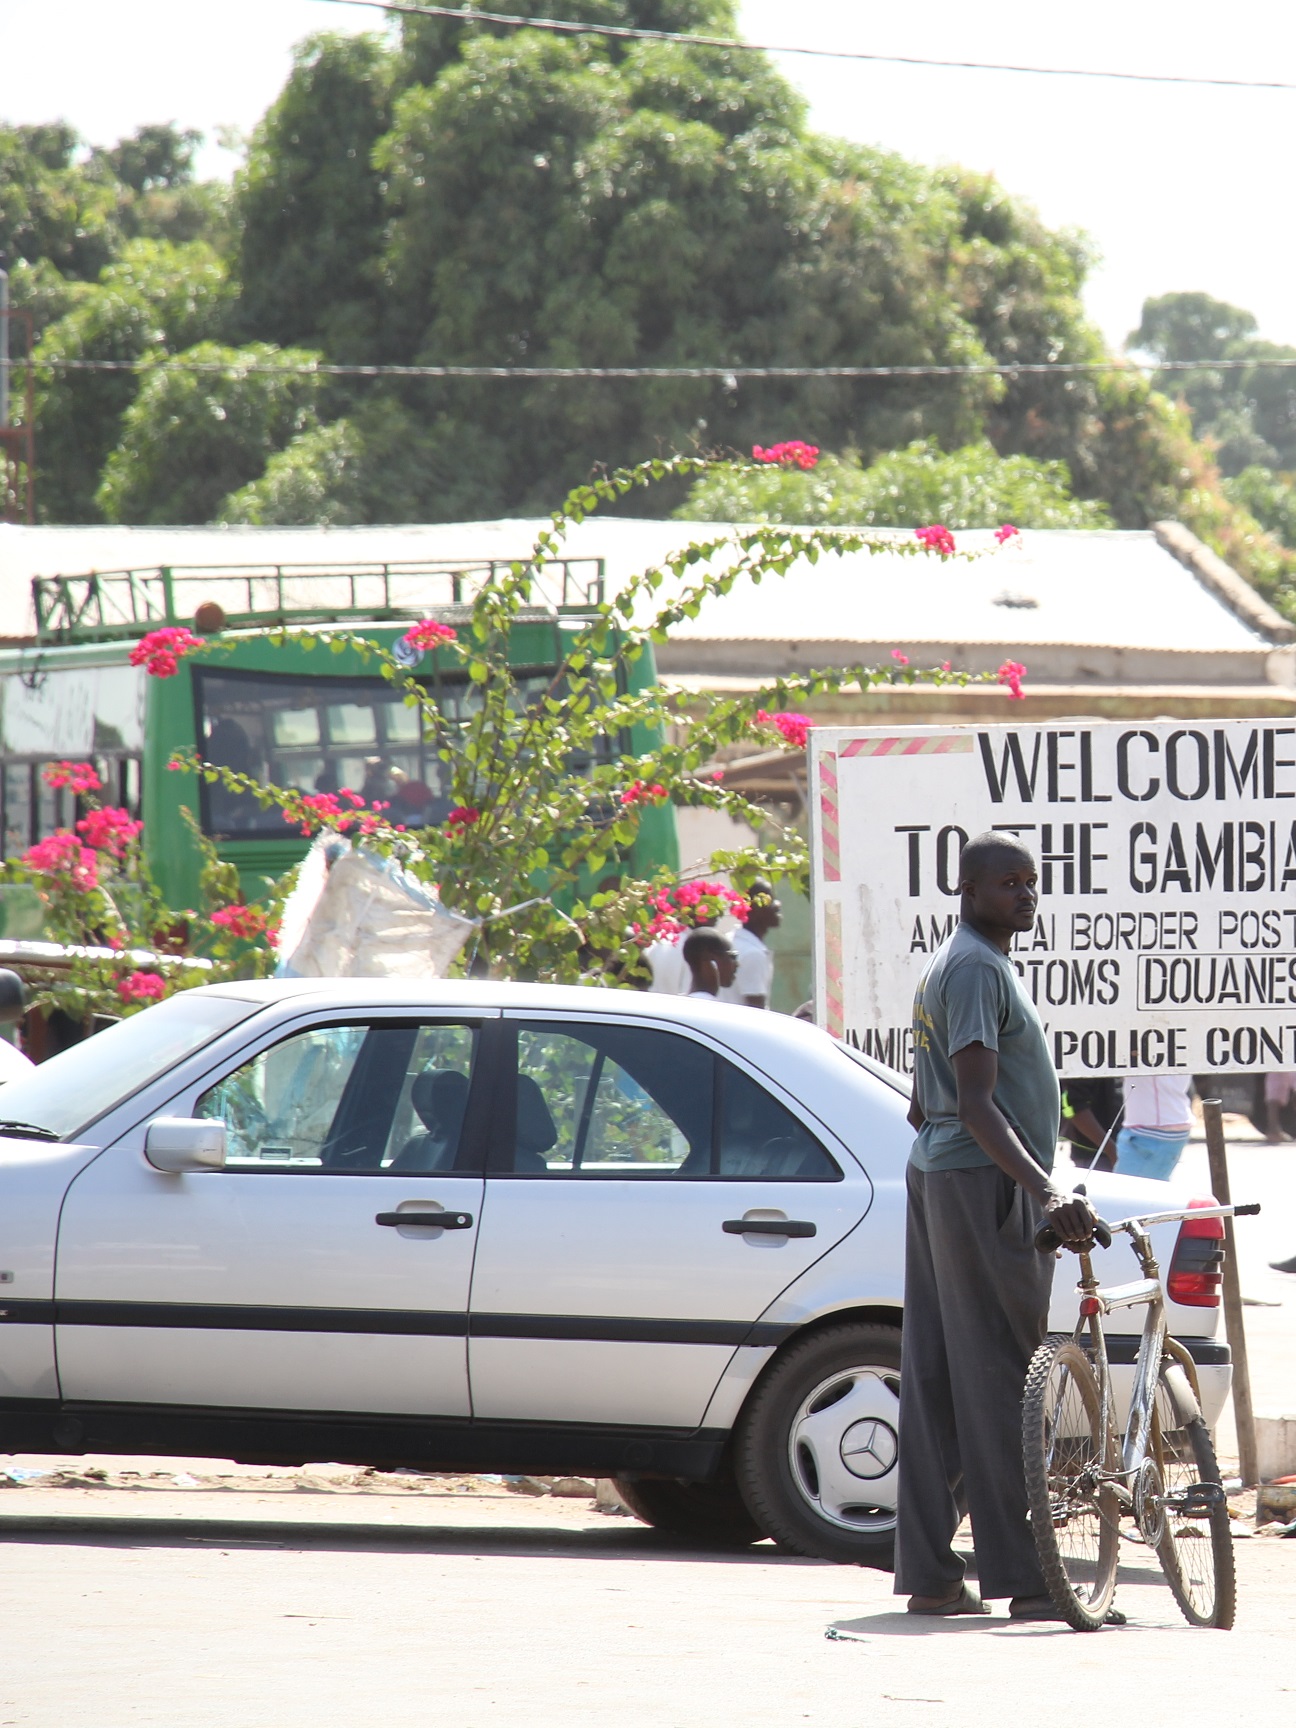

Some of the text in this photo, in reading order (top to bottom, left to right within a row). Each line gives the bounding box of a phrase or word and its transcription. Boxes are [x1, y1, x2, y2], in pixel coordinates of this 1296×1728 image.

[978, 728, 1296, 803] WELCOME
[895, 825, 969, 897] TO
[1071, 911, 1199, 951] BORDER
